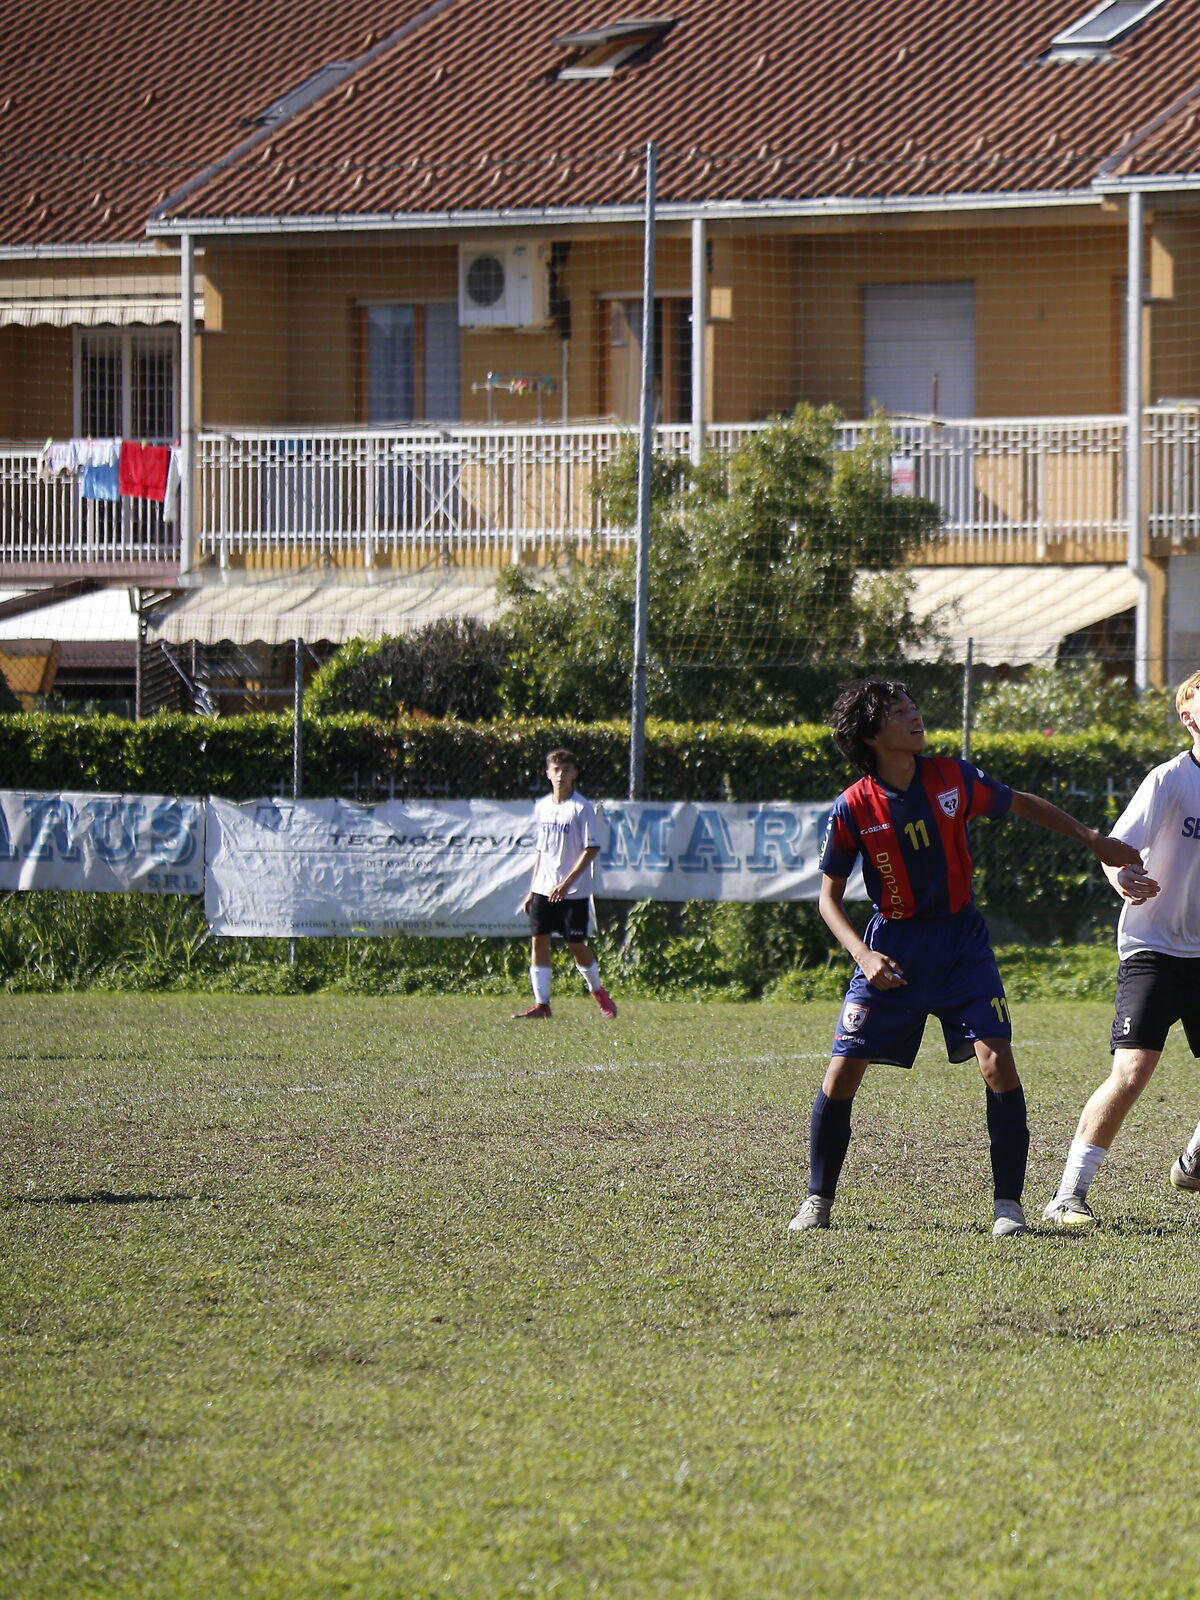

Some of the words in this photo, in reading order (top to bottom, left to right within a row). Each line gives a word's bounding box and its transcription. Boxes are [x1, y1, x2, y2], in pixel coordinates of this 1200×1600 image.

[330, 834, 536, 849] TECNOSERVIC
[904, 819, 930, 851] 11
[146, 873, 199, 890] SRL
[991, 997, 1011, 1024] 11
[1122, 1017, 1131, 1036] 5
